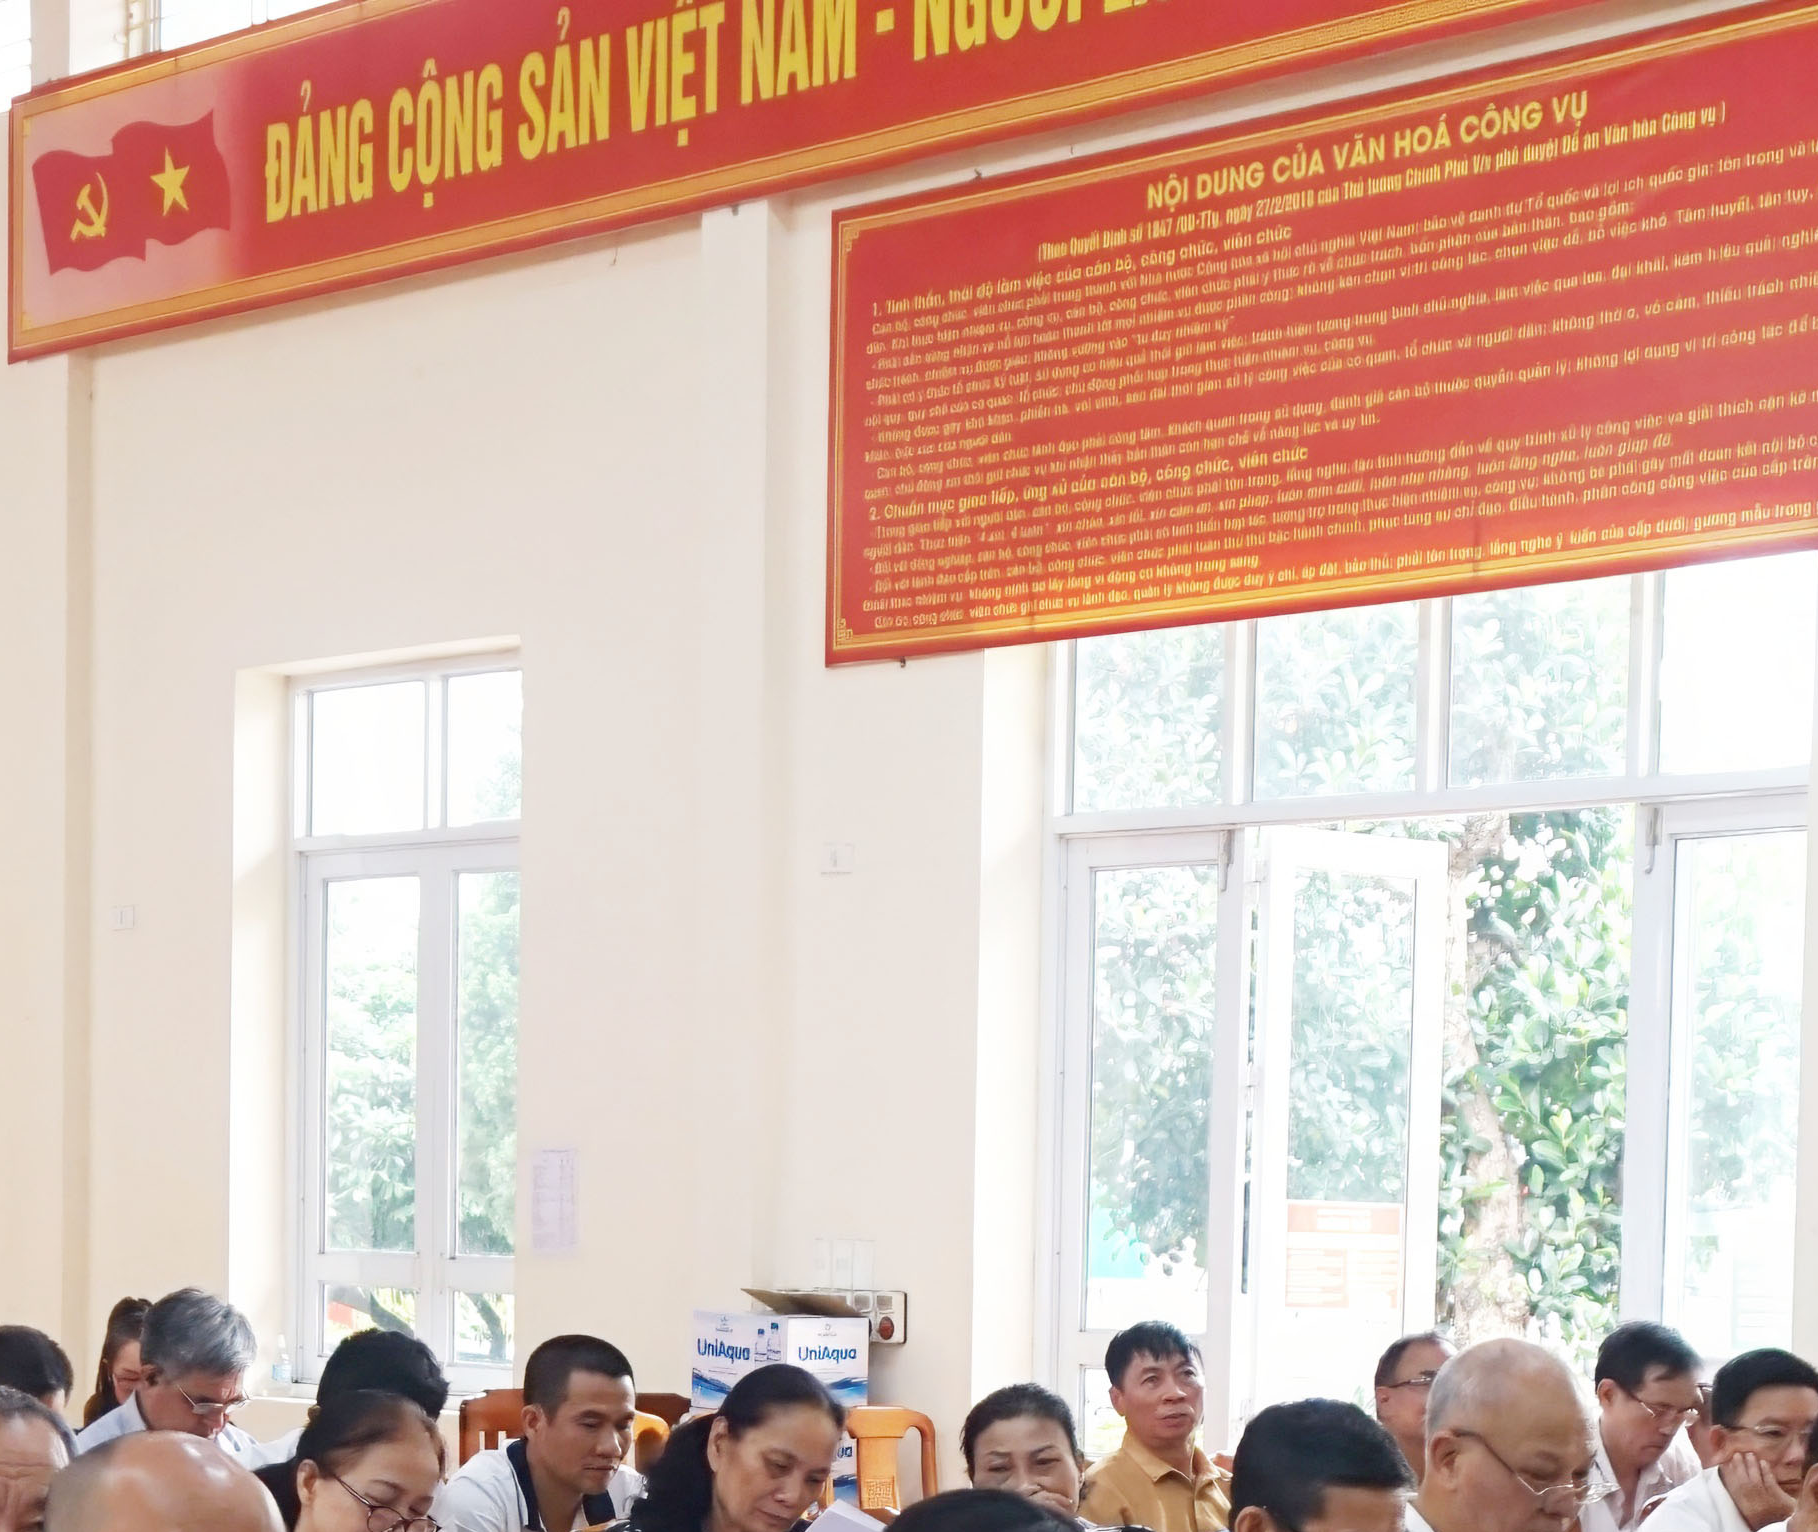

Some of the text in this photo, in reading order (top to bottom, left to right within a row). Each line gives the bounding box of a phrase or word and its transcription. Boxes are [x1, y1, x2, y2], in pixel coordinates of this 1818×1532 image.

[266, 80, 373, 223] ĐẢNG
[388, 58, 502, 208] CỘNG
[518, 6, 610, 160] SẢN
[626, 0, 726, 147] VIỆT
[741, 0, 857, 105] NAM
[876, 9, 894, 33] -
[1146, 90, 1588, 213] NỘI DUNG CỦA VĂN HOÁ CÔNG VỤ
[697, 1338, 751, 1364] UniAqua
[798, 1345, 857, 1364] UniAqua
